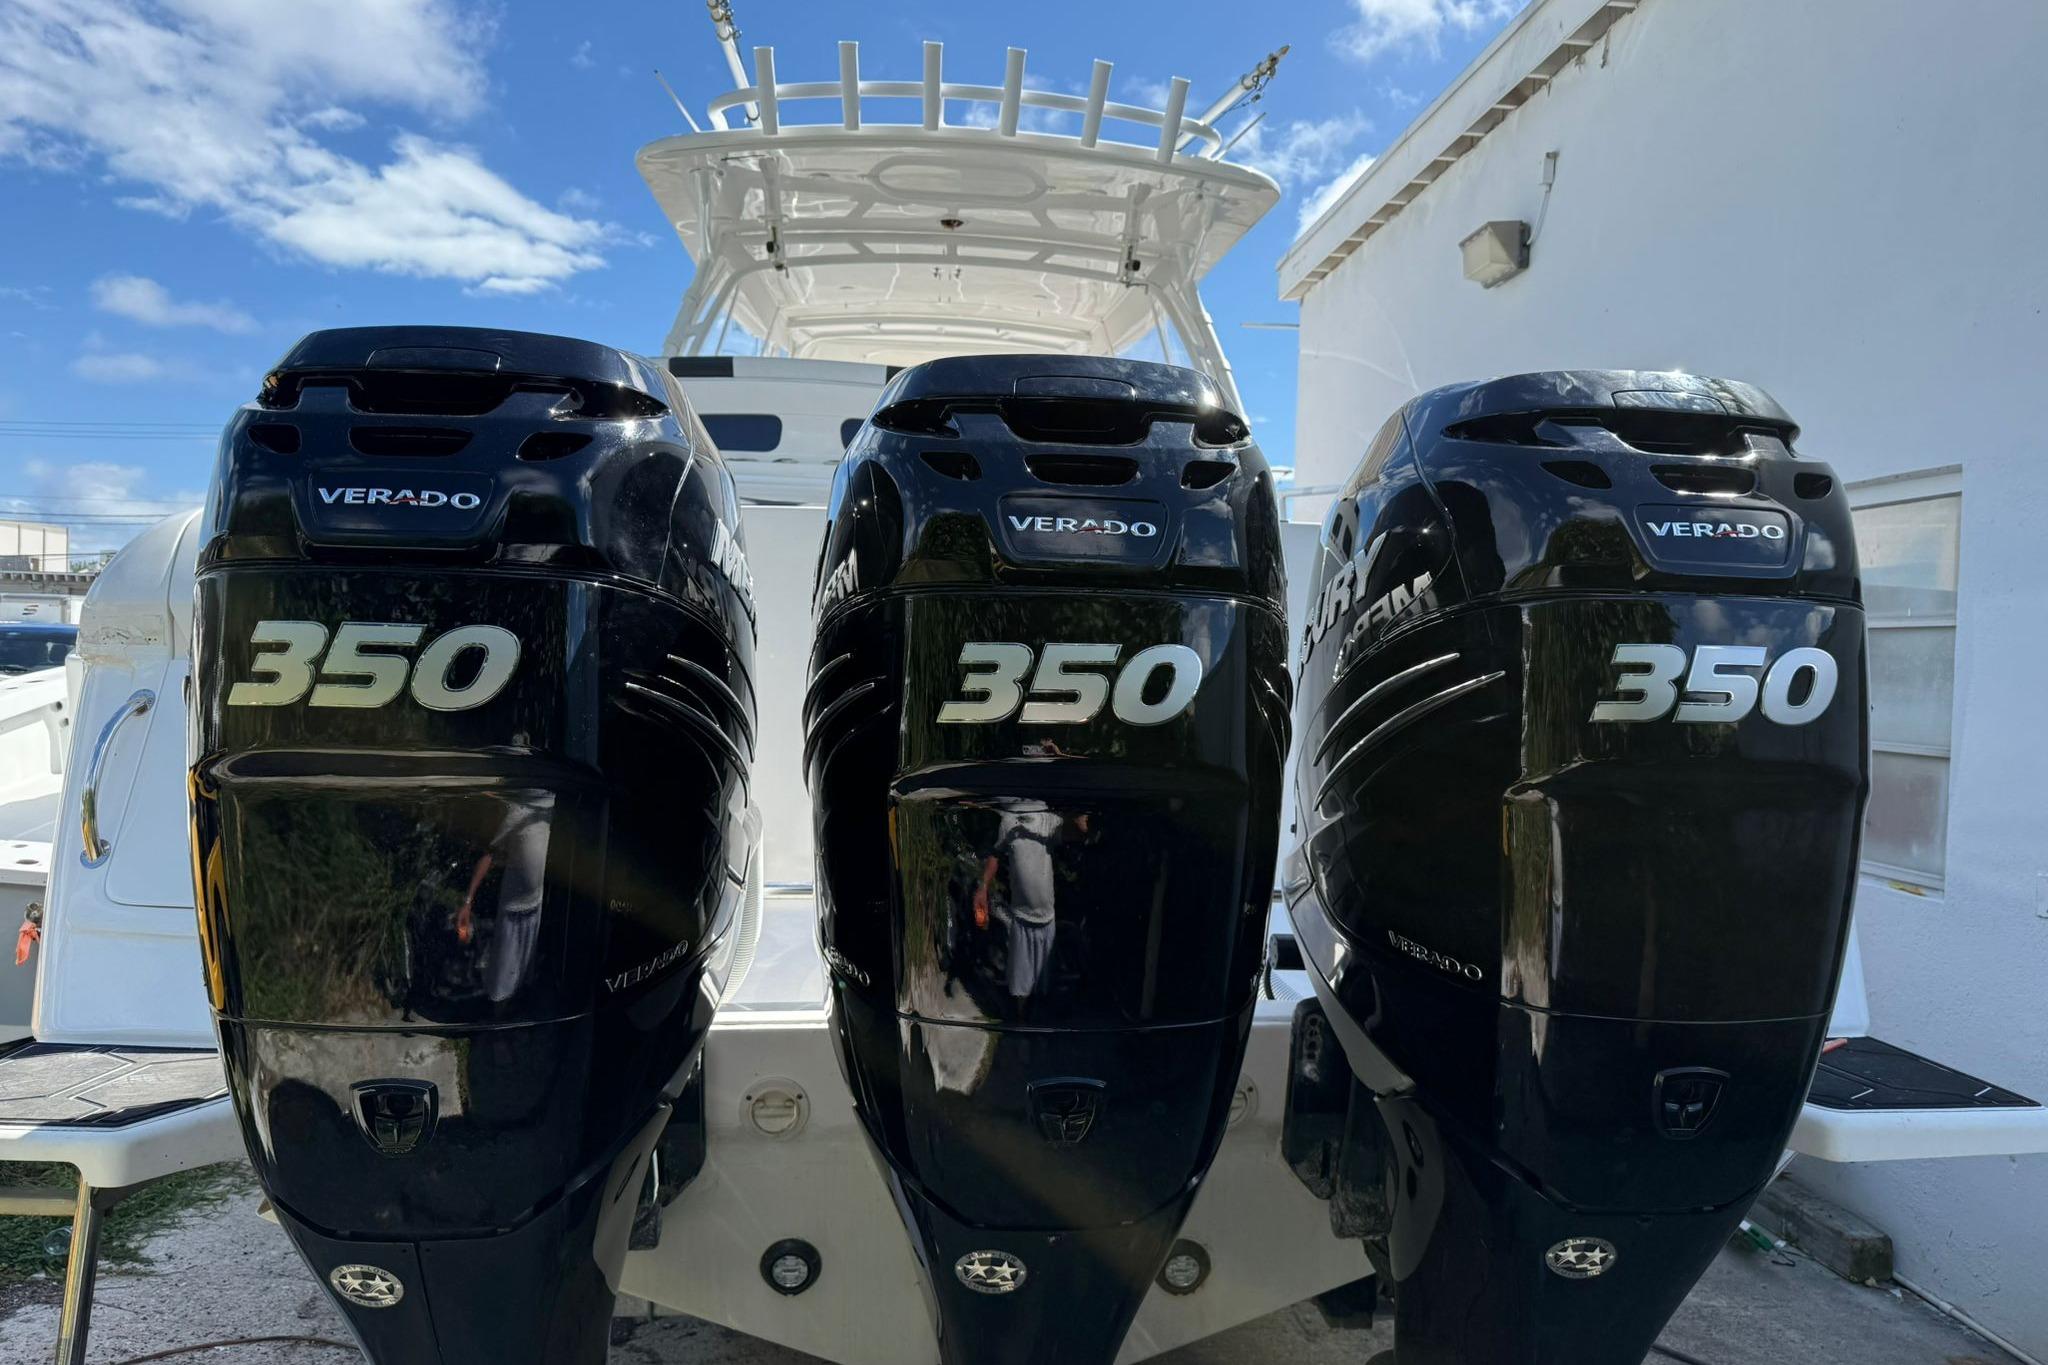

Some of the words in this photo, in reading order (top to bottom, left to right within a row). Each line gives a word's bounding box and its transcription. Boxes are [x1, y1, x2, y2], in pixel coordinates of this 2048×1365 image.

[318, 487, 481, 510] VERADO
[1008, 515, 1157, 537] VERADO
[1646, 521, 1785, 541] VERADO
[227, 620, 523, 711] 350
[936, 641, 1204, 725] 350
[1590, 643, 1838, 725] 350
[1388, 930, 1483, 981] VERADO
